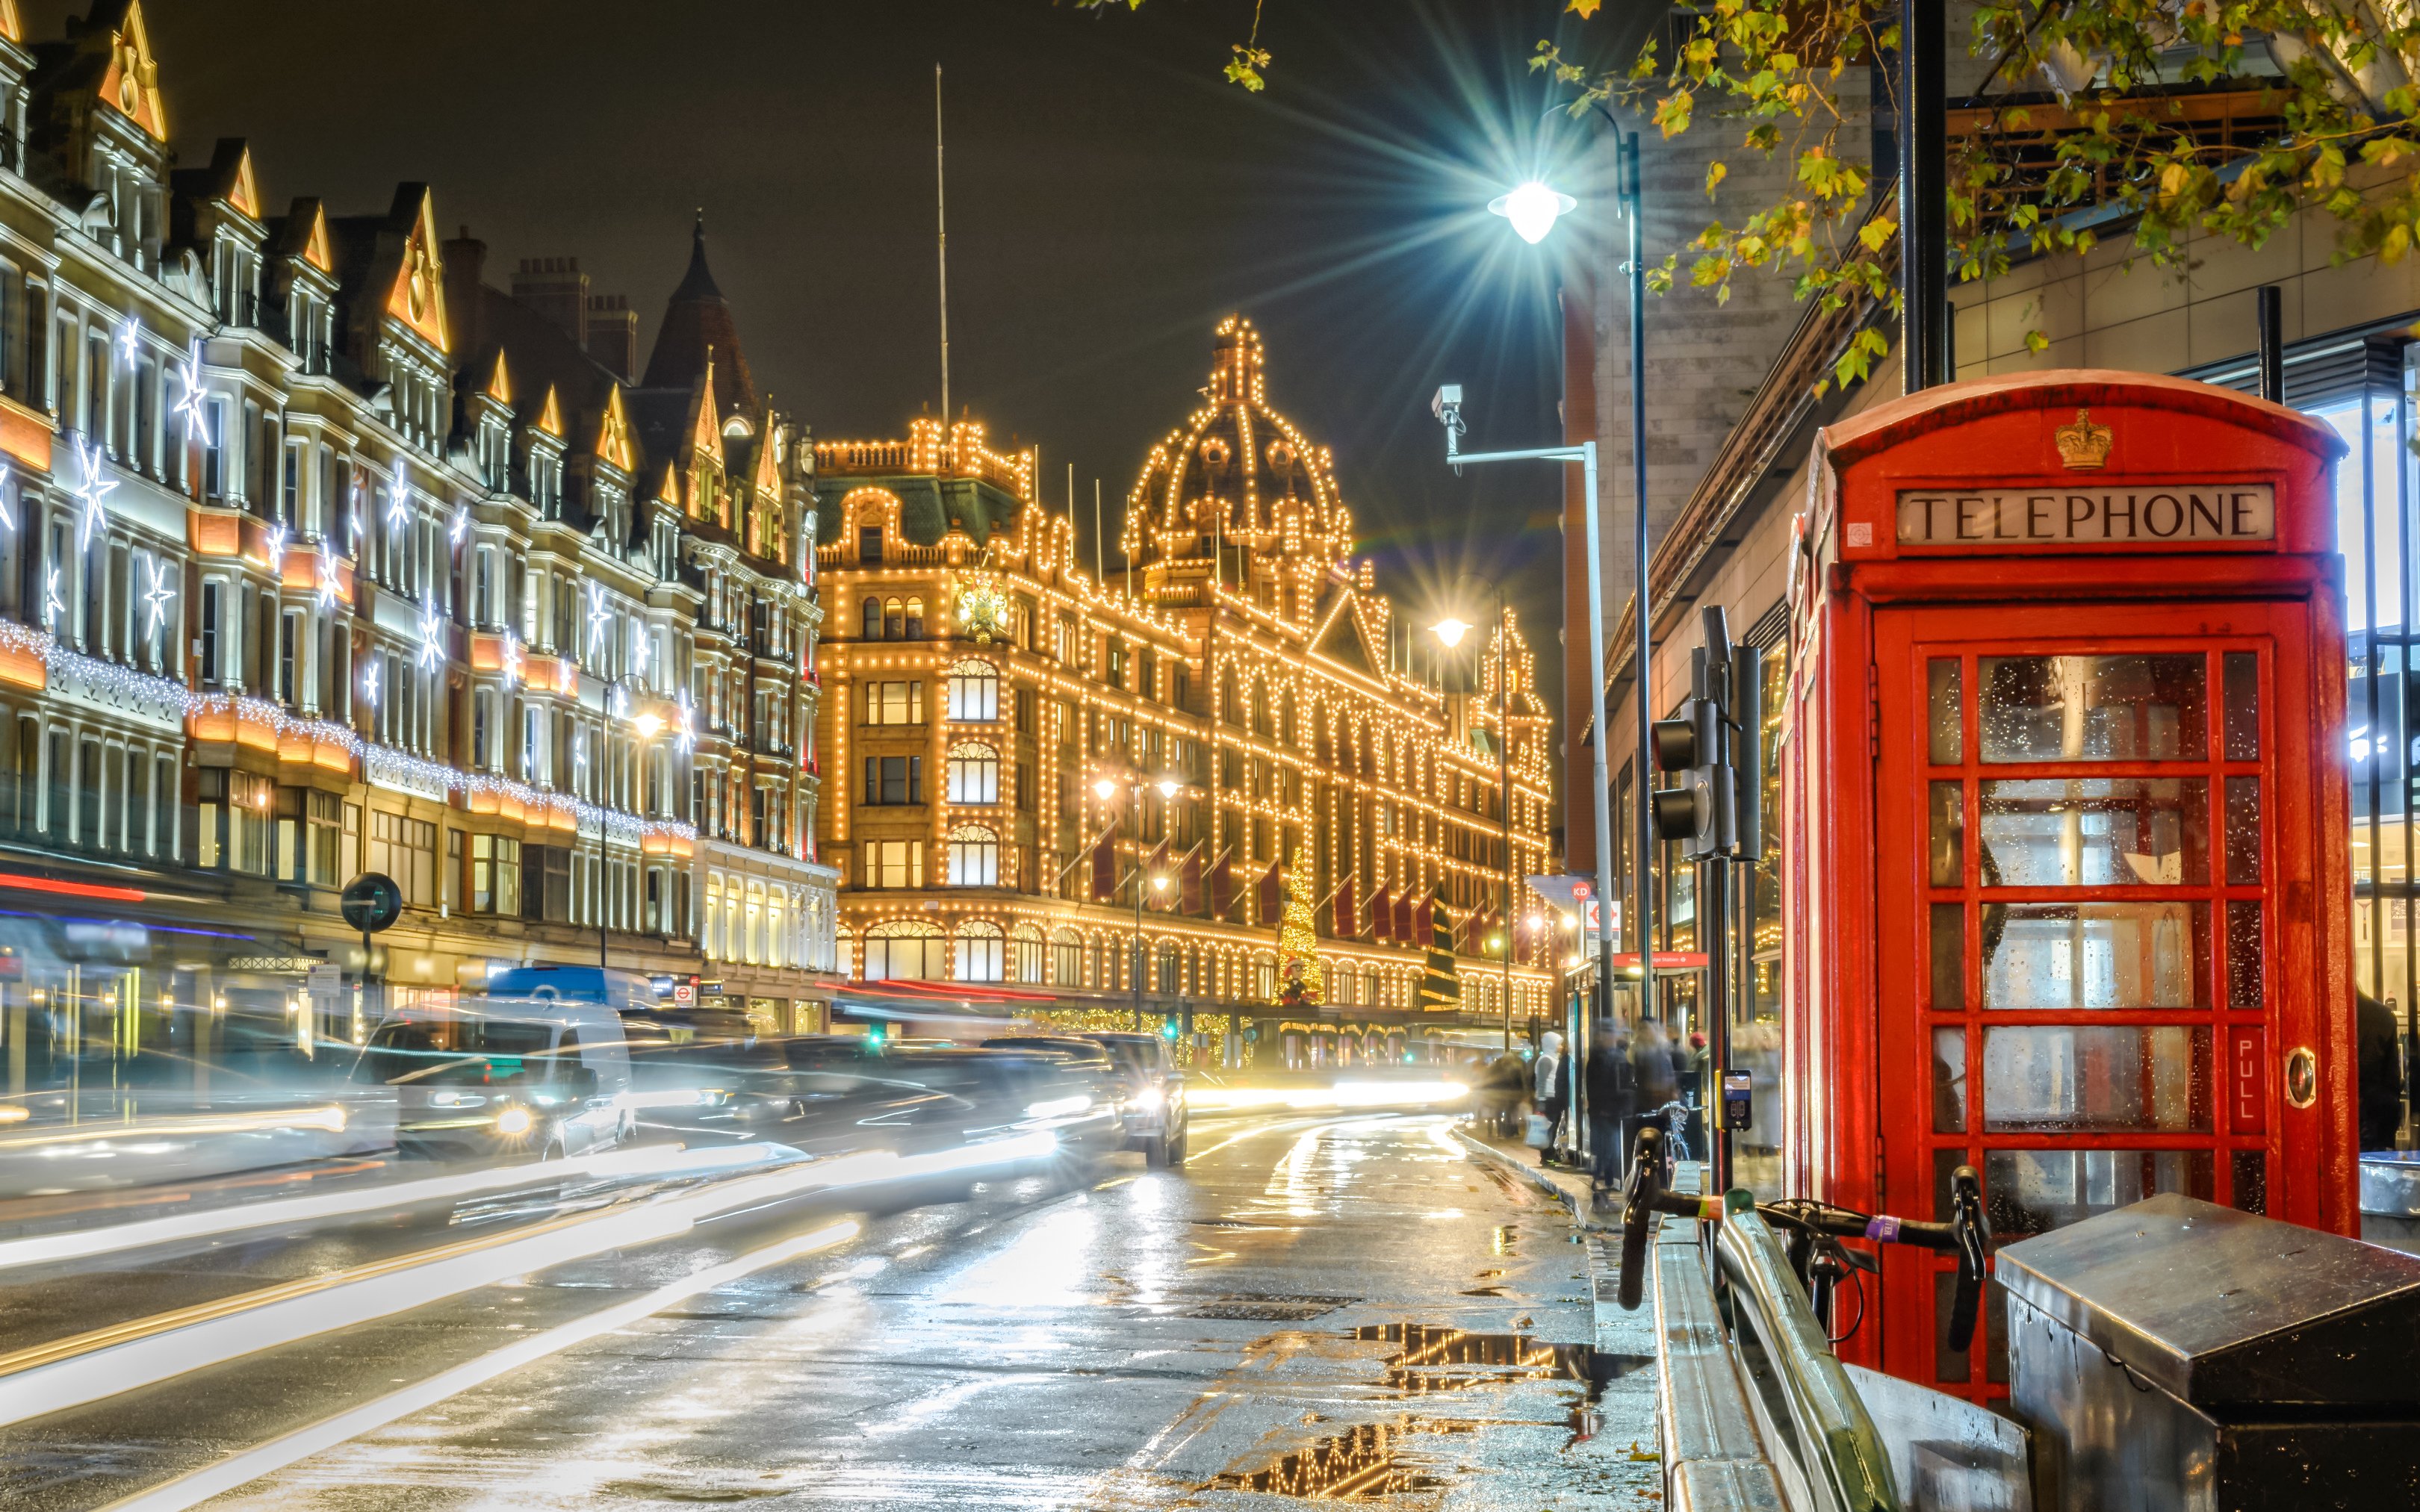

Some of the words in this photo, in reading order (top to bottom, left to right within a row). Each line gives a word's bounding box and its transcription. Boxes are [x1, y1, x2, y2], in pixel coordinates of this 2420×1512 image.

[1909, 492, 2259, 541] TELEPHONE
[1573, 888, 1587, 896] KD
[2239, 1039, 2254, 1119] PULL
